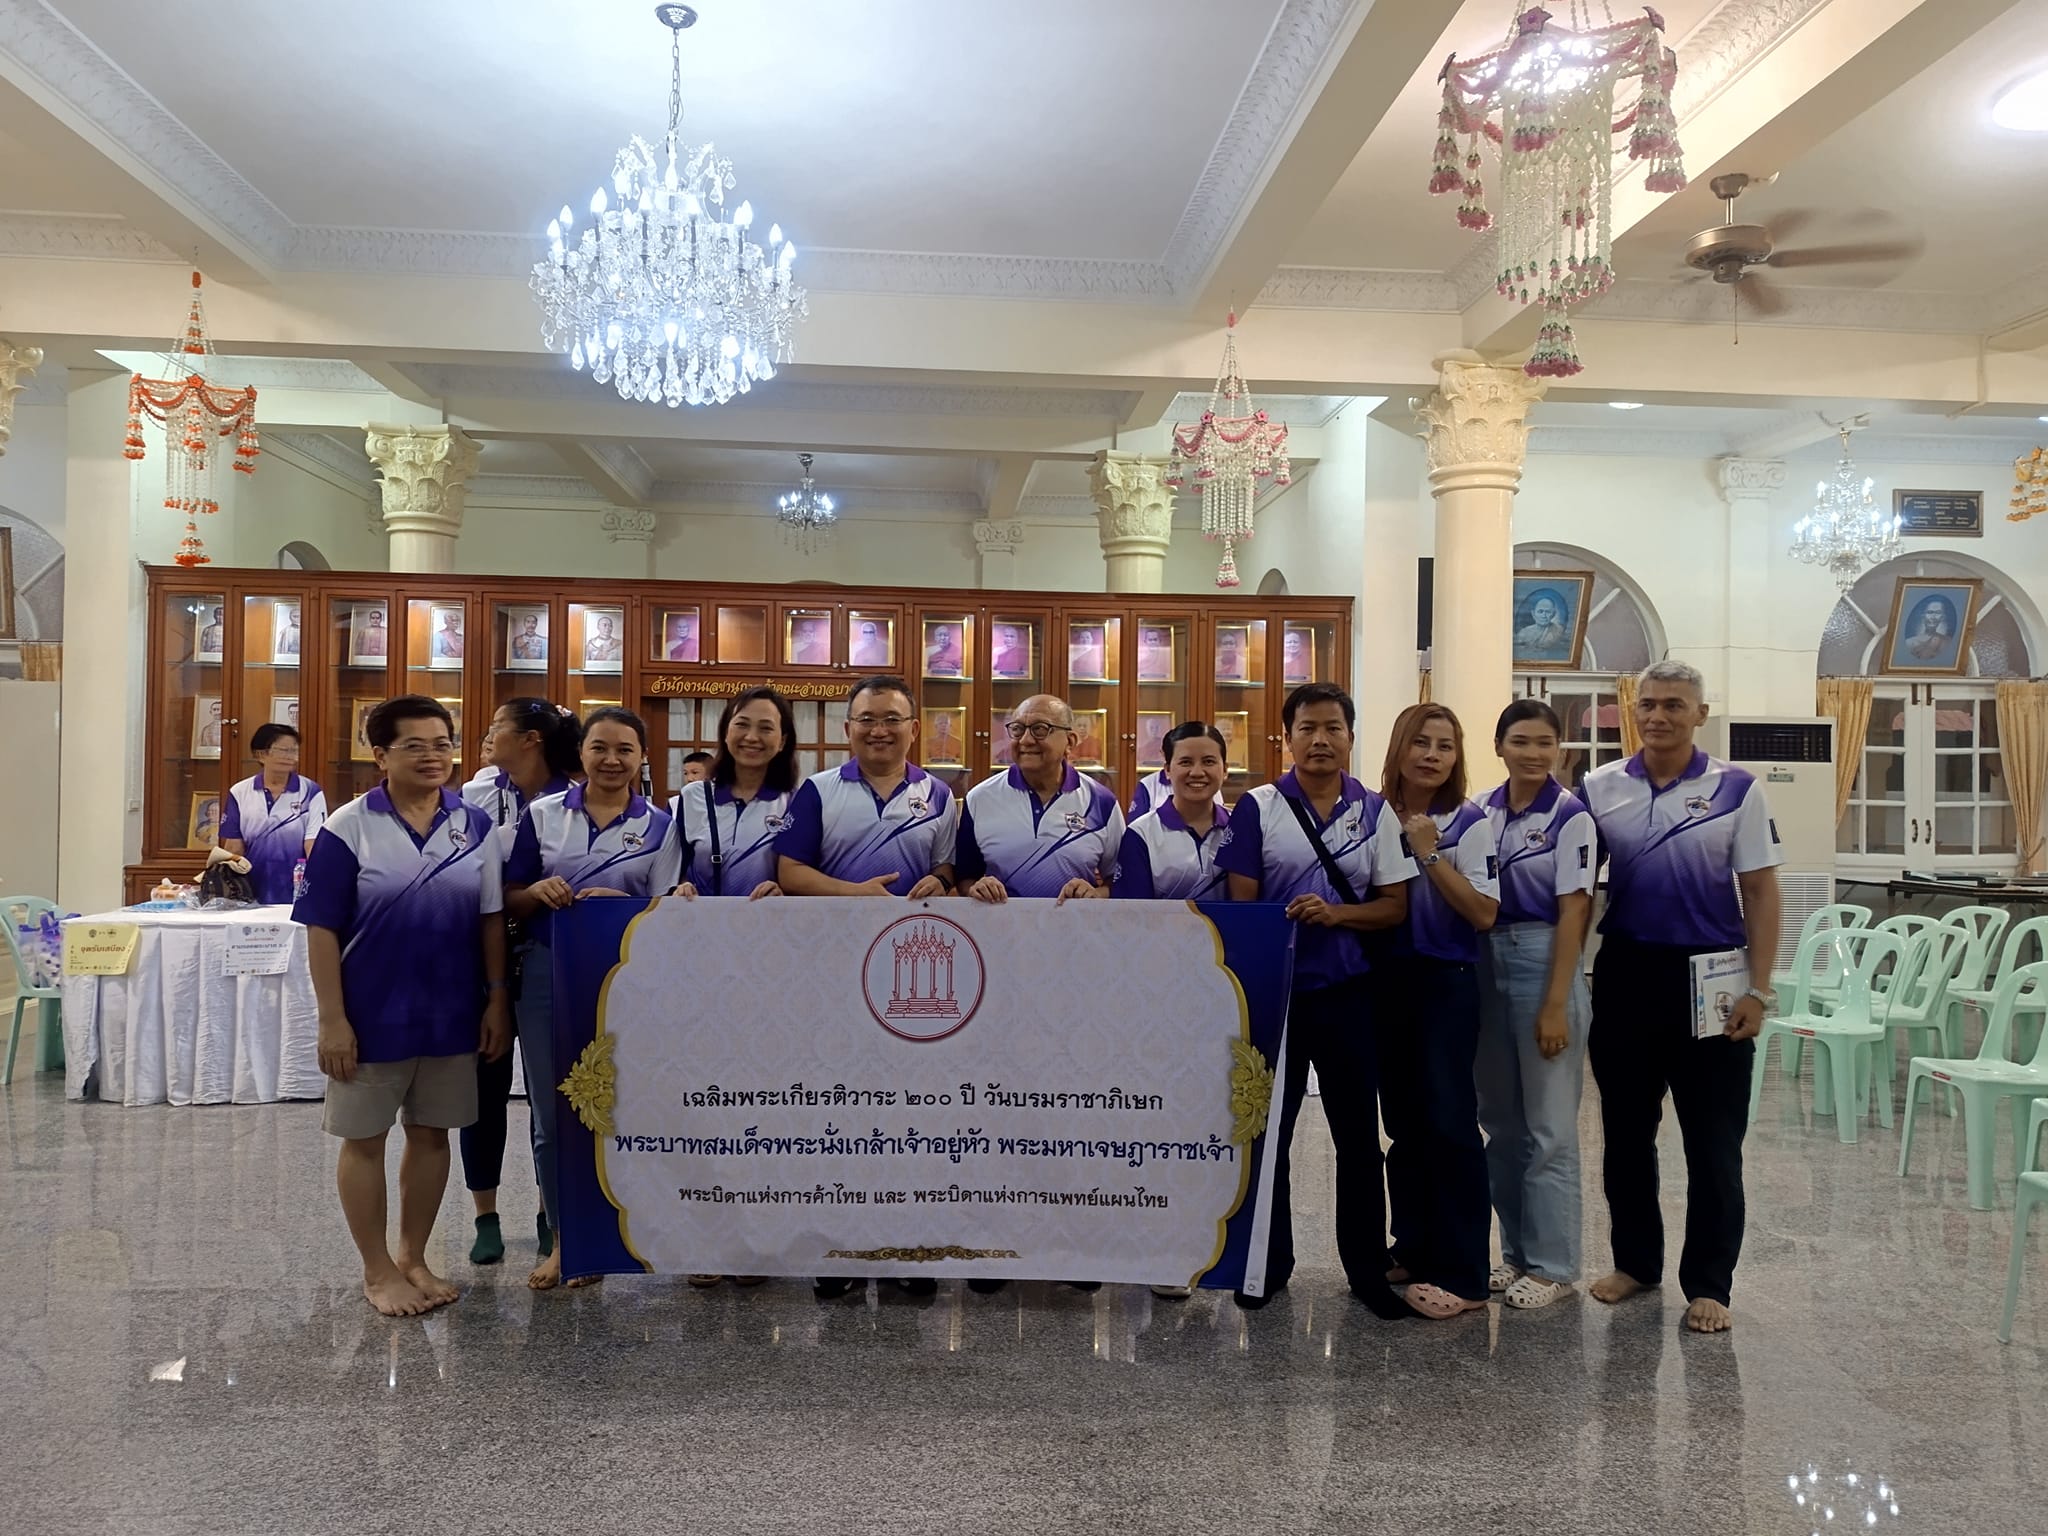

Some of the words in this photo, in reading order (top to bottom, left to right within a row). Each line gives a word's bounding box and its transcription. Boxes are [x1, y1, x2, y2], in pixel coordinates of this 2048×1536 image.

[682, 1081, 897, 1108] เฉลิมพระเกียรติวาระ
[904, 1089, 952, 1106] ๒๐๐
[959, 1081, 976, 1106] ปี
[983, 1082, 1164, 1111] วันบรมราชาภิเษก
[614, 1122, 991, 1164] พระบาทสมเด็จพระนั่งเกล้าเจ้าอยู่หัว
[997, 1133, 1235, 1168] พระมหาเจษฎาราชเจ้า
[678, 1183, 867, 1205] พระบิดาแห่งการค้าไทย
[873, 1190, 908, 1205] และ
[912, 1184, 1169, 1209] พระบิดาแห่งการแพทย์แผนไทย
